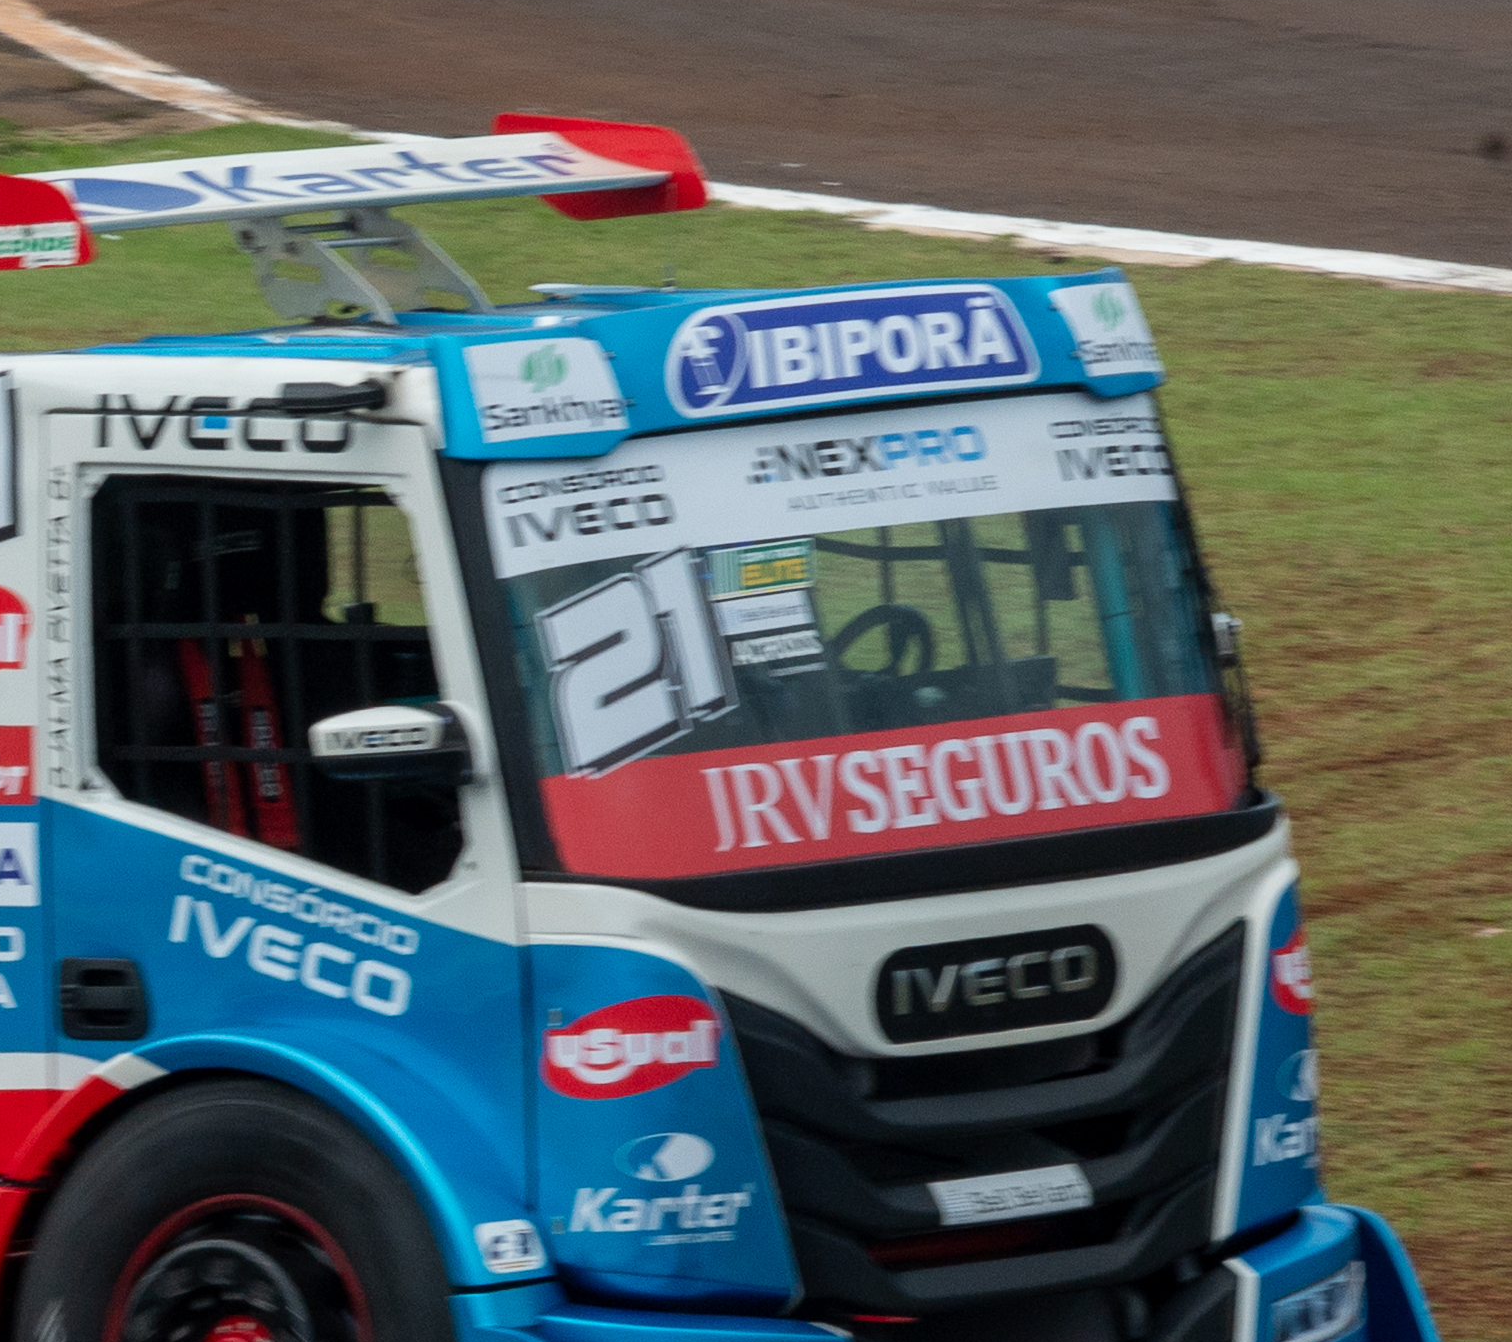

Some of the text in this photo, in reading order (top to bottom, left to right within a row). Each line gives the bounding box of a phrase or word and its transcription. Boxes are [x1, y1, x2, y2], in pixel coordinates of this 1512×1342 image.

[183, 150, 579, 204] Karter
[744, 296, 1017, 389] IBIPORÃ
[505, 493, 675, 548] IVECO
[533, 546, 739, 780] 21
[179, 854, 421, 956] CONSÓRCIO
[167, 894, 413, 1017] IVECO
[891, 944, 1099, 1016] IVECO
[547, 1018, 720, 1084] usual
[567, 1182, 754, 1232] Karter
